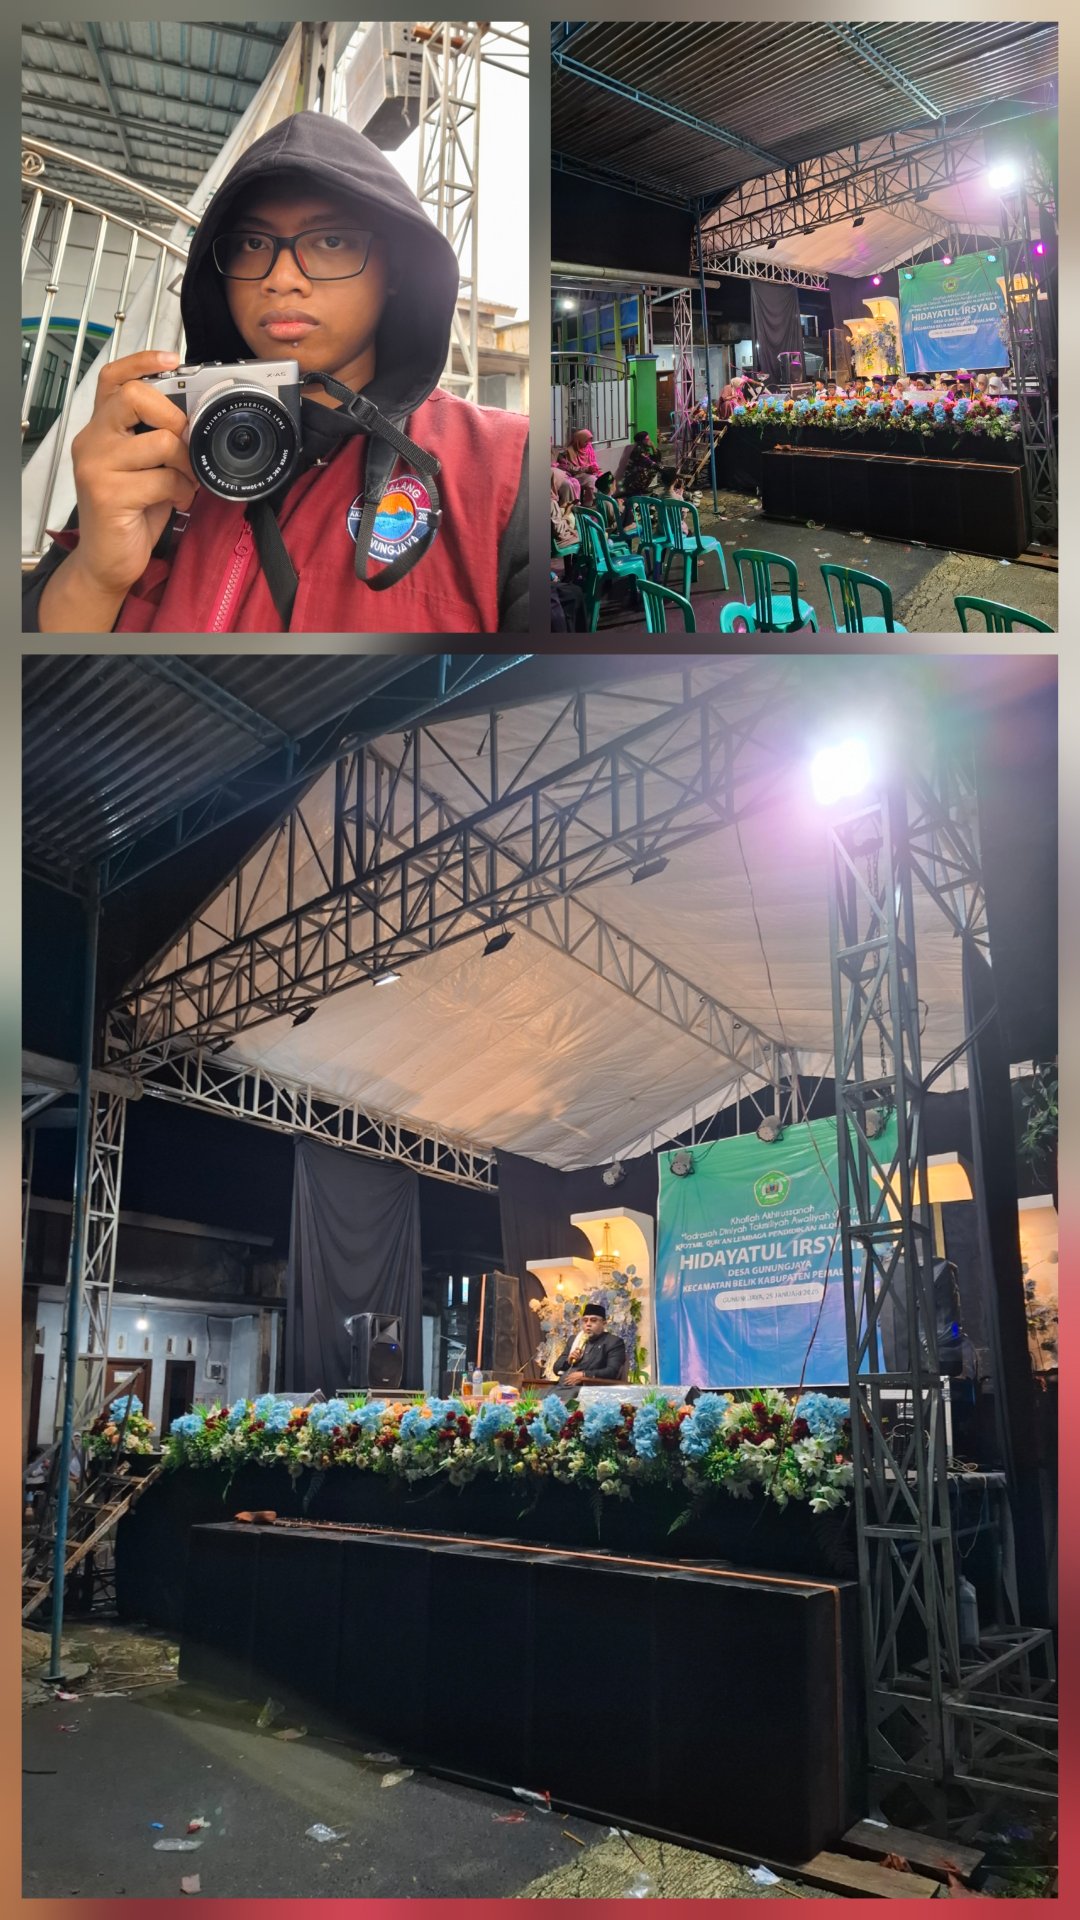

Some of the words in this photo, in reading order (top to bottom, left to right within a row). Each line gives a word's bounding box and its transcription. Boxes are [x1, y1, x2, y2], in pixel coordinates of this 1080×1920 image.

[911, 308, 960, 322] HIDAYATUL
[961, 302, 997, 315] IRSYAD
[203, 408, 227, 435] FUJINON
[229, 402, 272, 415] ASPHERICAL
[272, 414, 286, 430] LENS
[680, 1242, 787, 1270] HIDAYATUL
[728, 1267, 749, 1277] DESA
[751, 1260, 812, 1275] GUNUNGJAYA
[683, 1281, 731, 1293] KECAMATAN
[732, 1278, 756, 1288] BELIK
[757, 1271, 811, 1285] KABUPATEN
[812, 1266, 862, 1280] PEMALN
